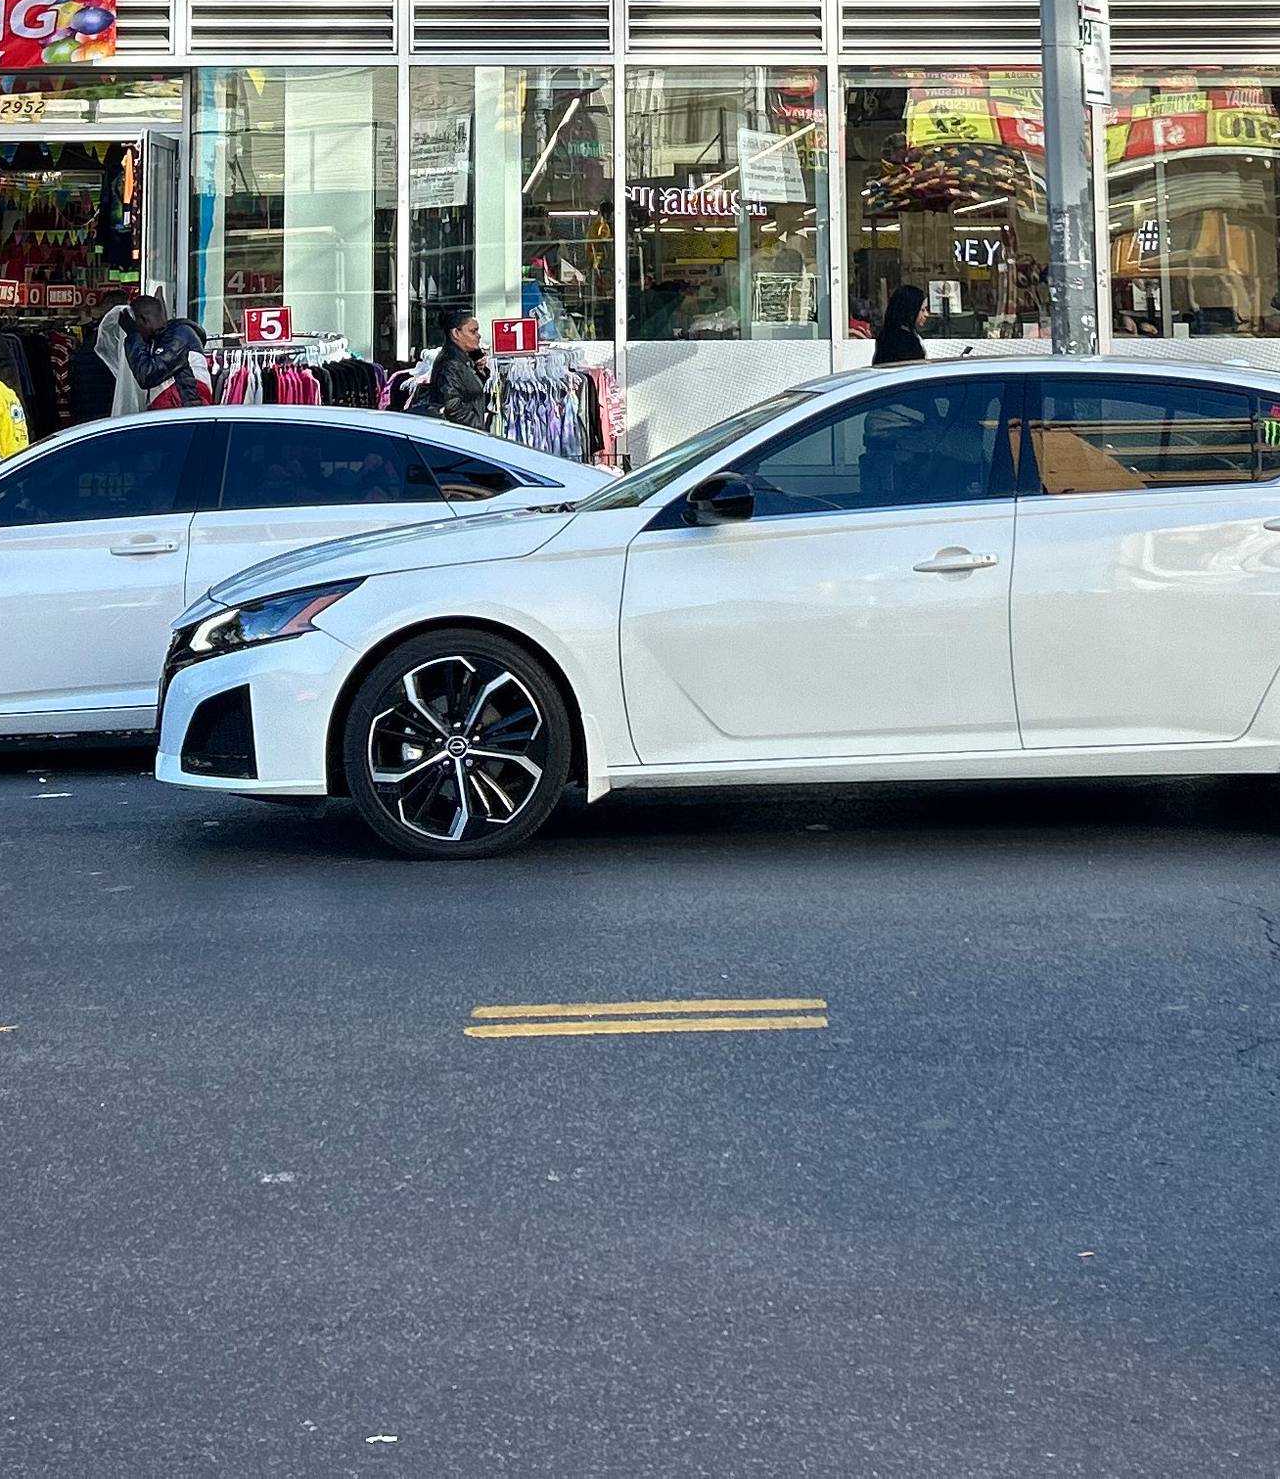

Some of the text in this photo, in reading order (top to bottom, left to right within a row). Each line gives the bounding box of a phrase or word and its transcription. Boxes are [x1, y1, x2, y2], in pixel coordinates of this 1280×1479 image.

[1, 100, 46, 114] 2952
[250, 310, 283, 340] $5
[502, 321, 526, 350] $1
